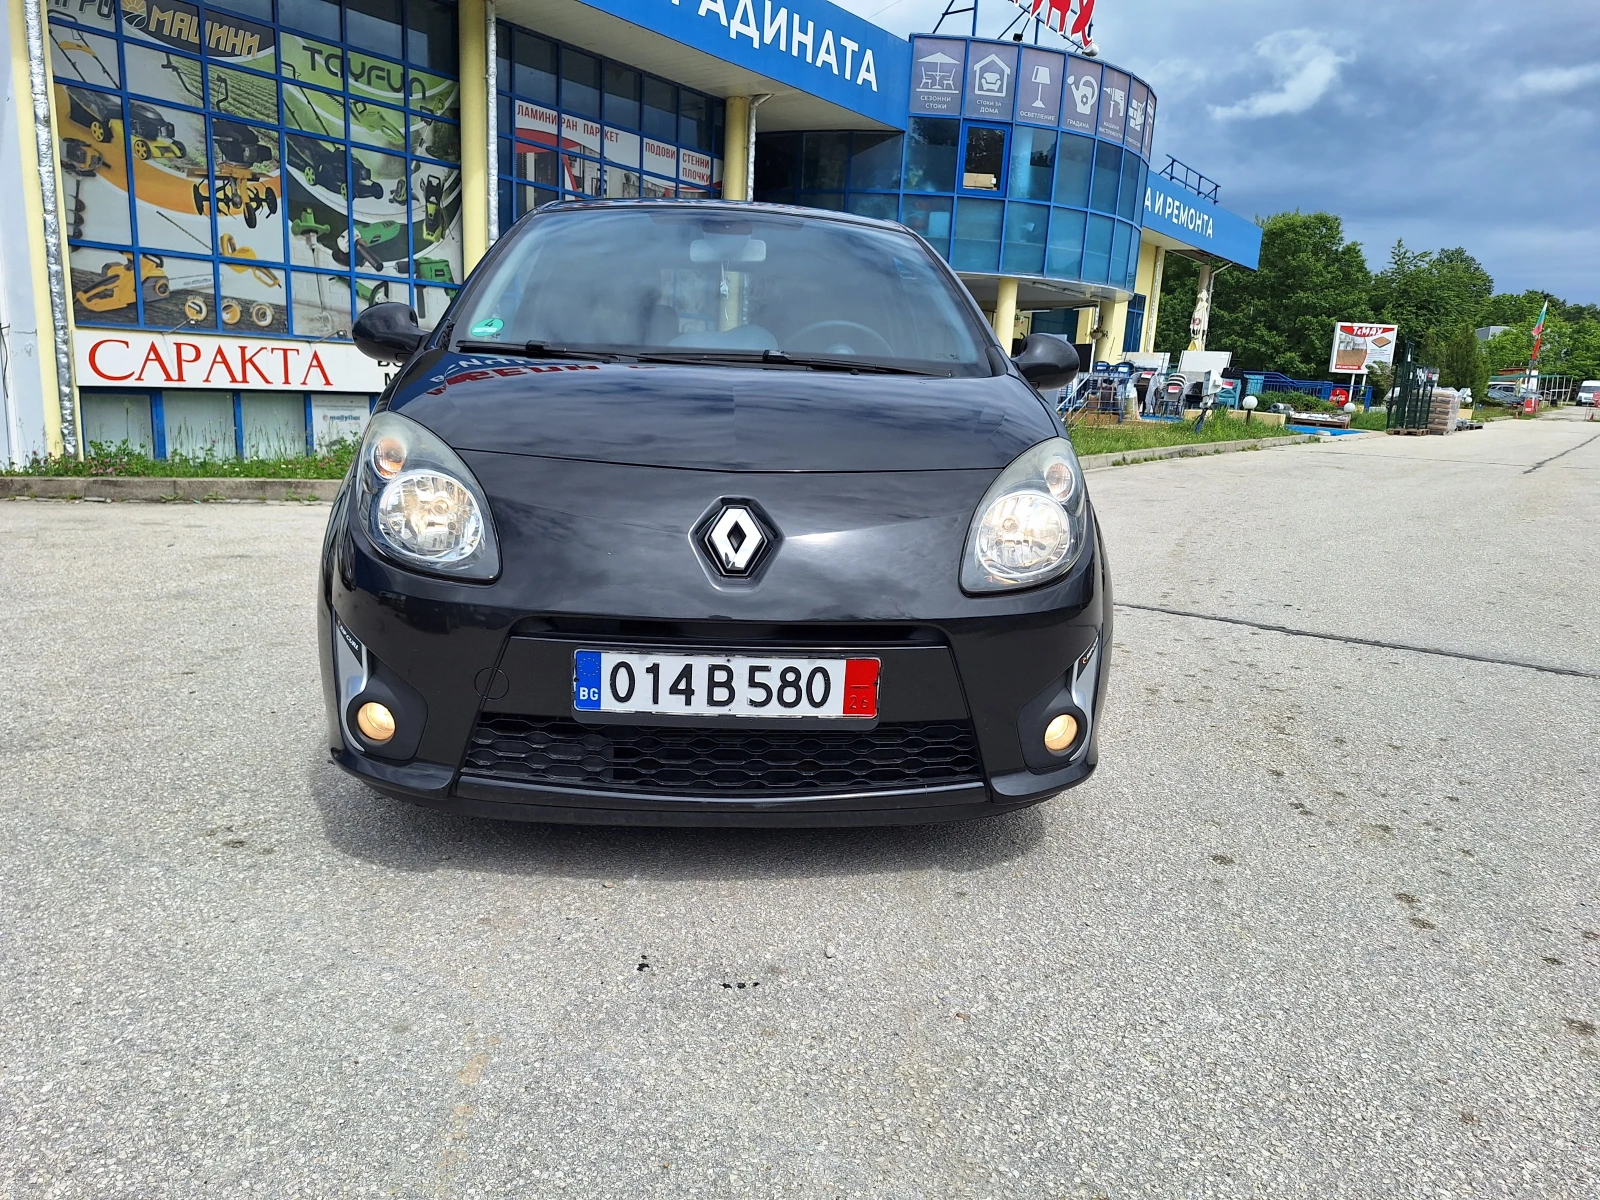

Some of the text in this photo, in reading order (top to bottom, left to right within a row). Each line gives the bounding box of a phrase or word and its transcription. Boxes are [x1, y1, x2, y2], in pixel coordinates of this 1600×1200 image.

[671, 0, 878, 93] АДИНАТА
[979, 106, 999, 114] ДОМА
[1019, 110, 1056, 121] ОСВЕТЛЕНИЕ
[517, 104, 620, 143] ЛАМИНИРАН ПАРКЕТ
[1067, 118, 1090, 129] ГРАДИНА
[645, 142, 676, 160] ПОДОВИ
[682, 153, 710, 170] СТЕННИ
[682, 168, 711, 184] ПЛОЧКИ
[1154, 190, 1164, 216] И
[1165, 196, 1213, 239] РЕМОНТА
[88, 339, 334, 386] САРАКТА
[579, 687, 599, 701] BG
